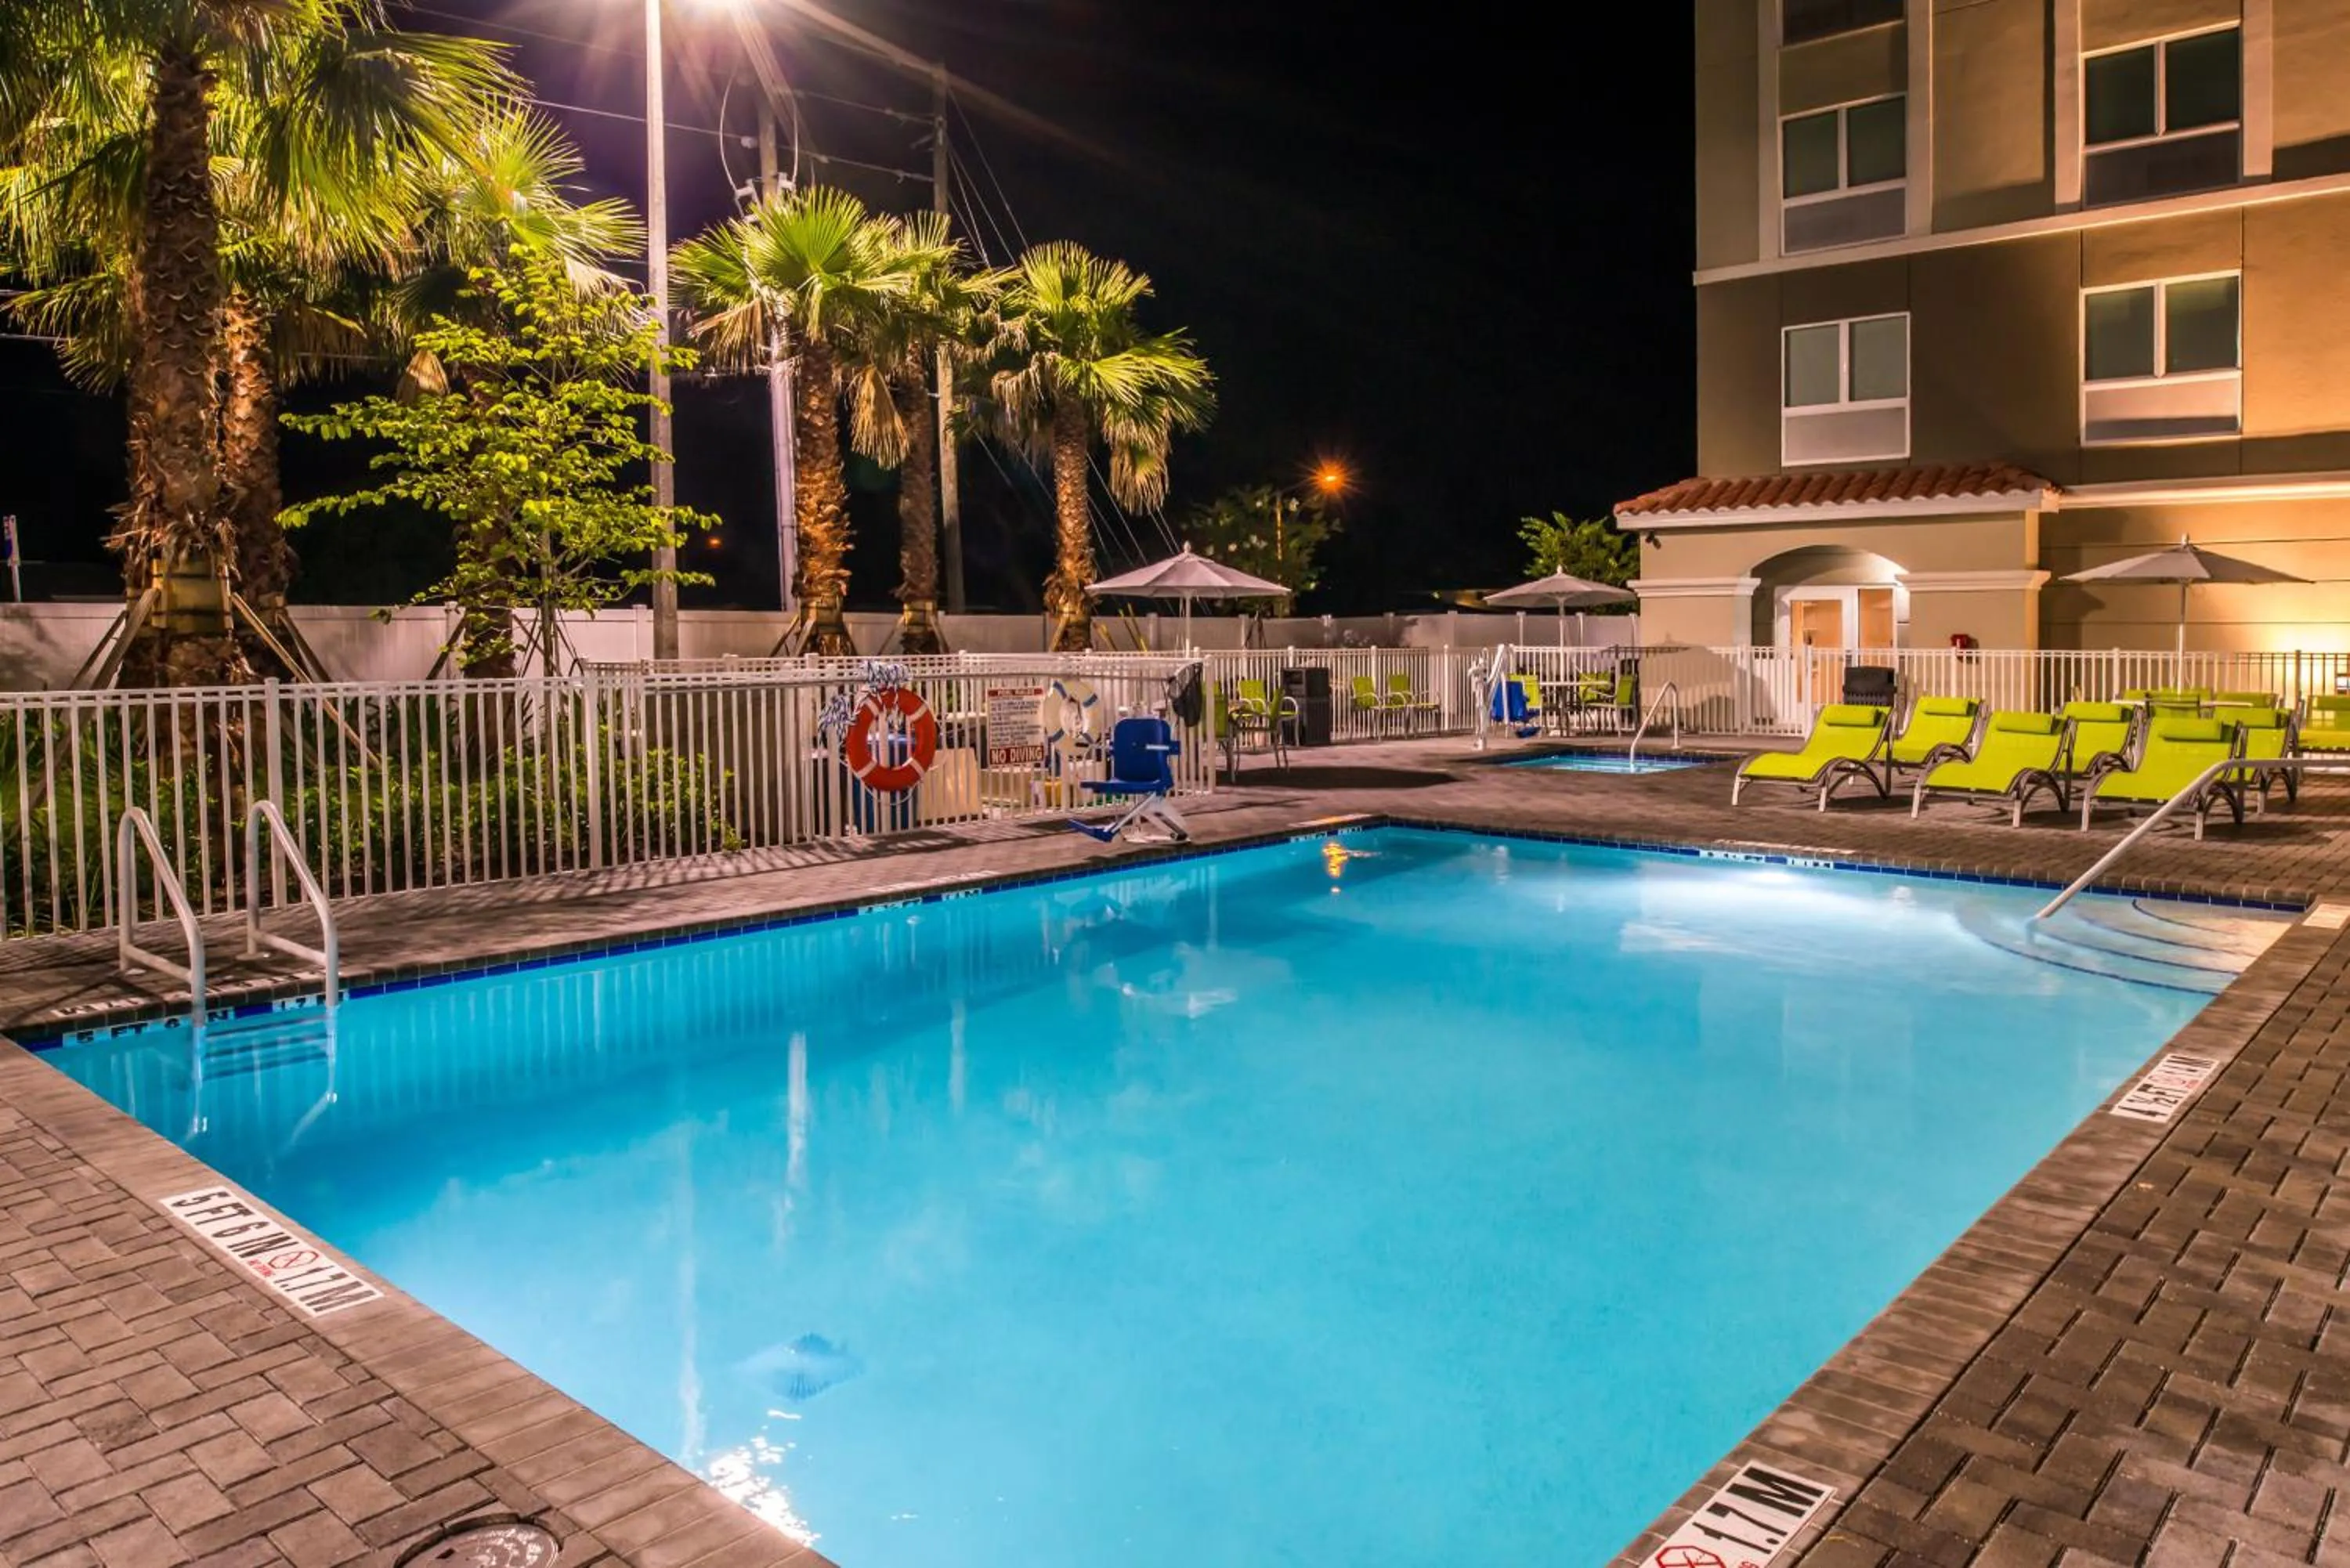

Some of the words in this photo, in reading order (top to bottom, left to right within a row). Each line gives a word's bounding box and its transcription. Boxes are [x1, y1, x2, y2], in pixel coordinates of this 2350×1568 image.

[991, 750, 1007, 764] NO
[1010, 746, 1043, 762] DIVING
[77, 1031, 94, 1043] 5
[110, 1022, 149, 1039] FT
[164, 1018, 181, 1028] 6
[2136, 1082, 2189, 1099] FT
[171, 1190, 230, 1208] 5
[184, 1201, 255, 1226] FT
[211, 1220, 269, 1238] 6
[226, 1231, 300, 1259] IN
